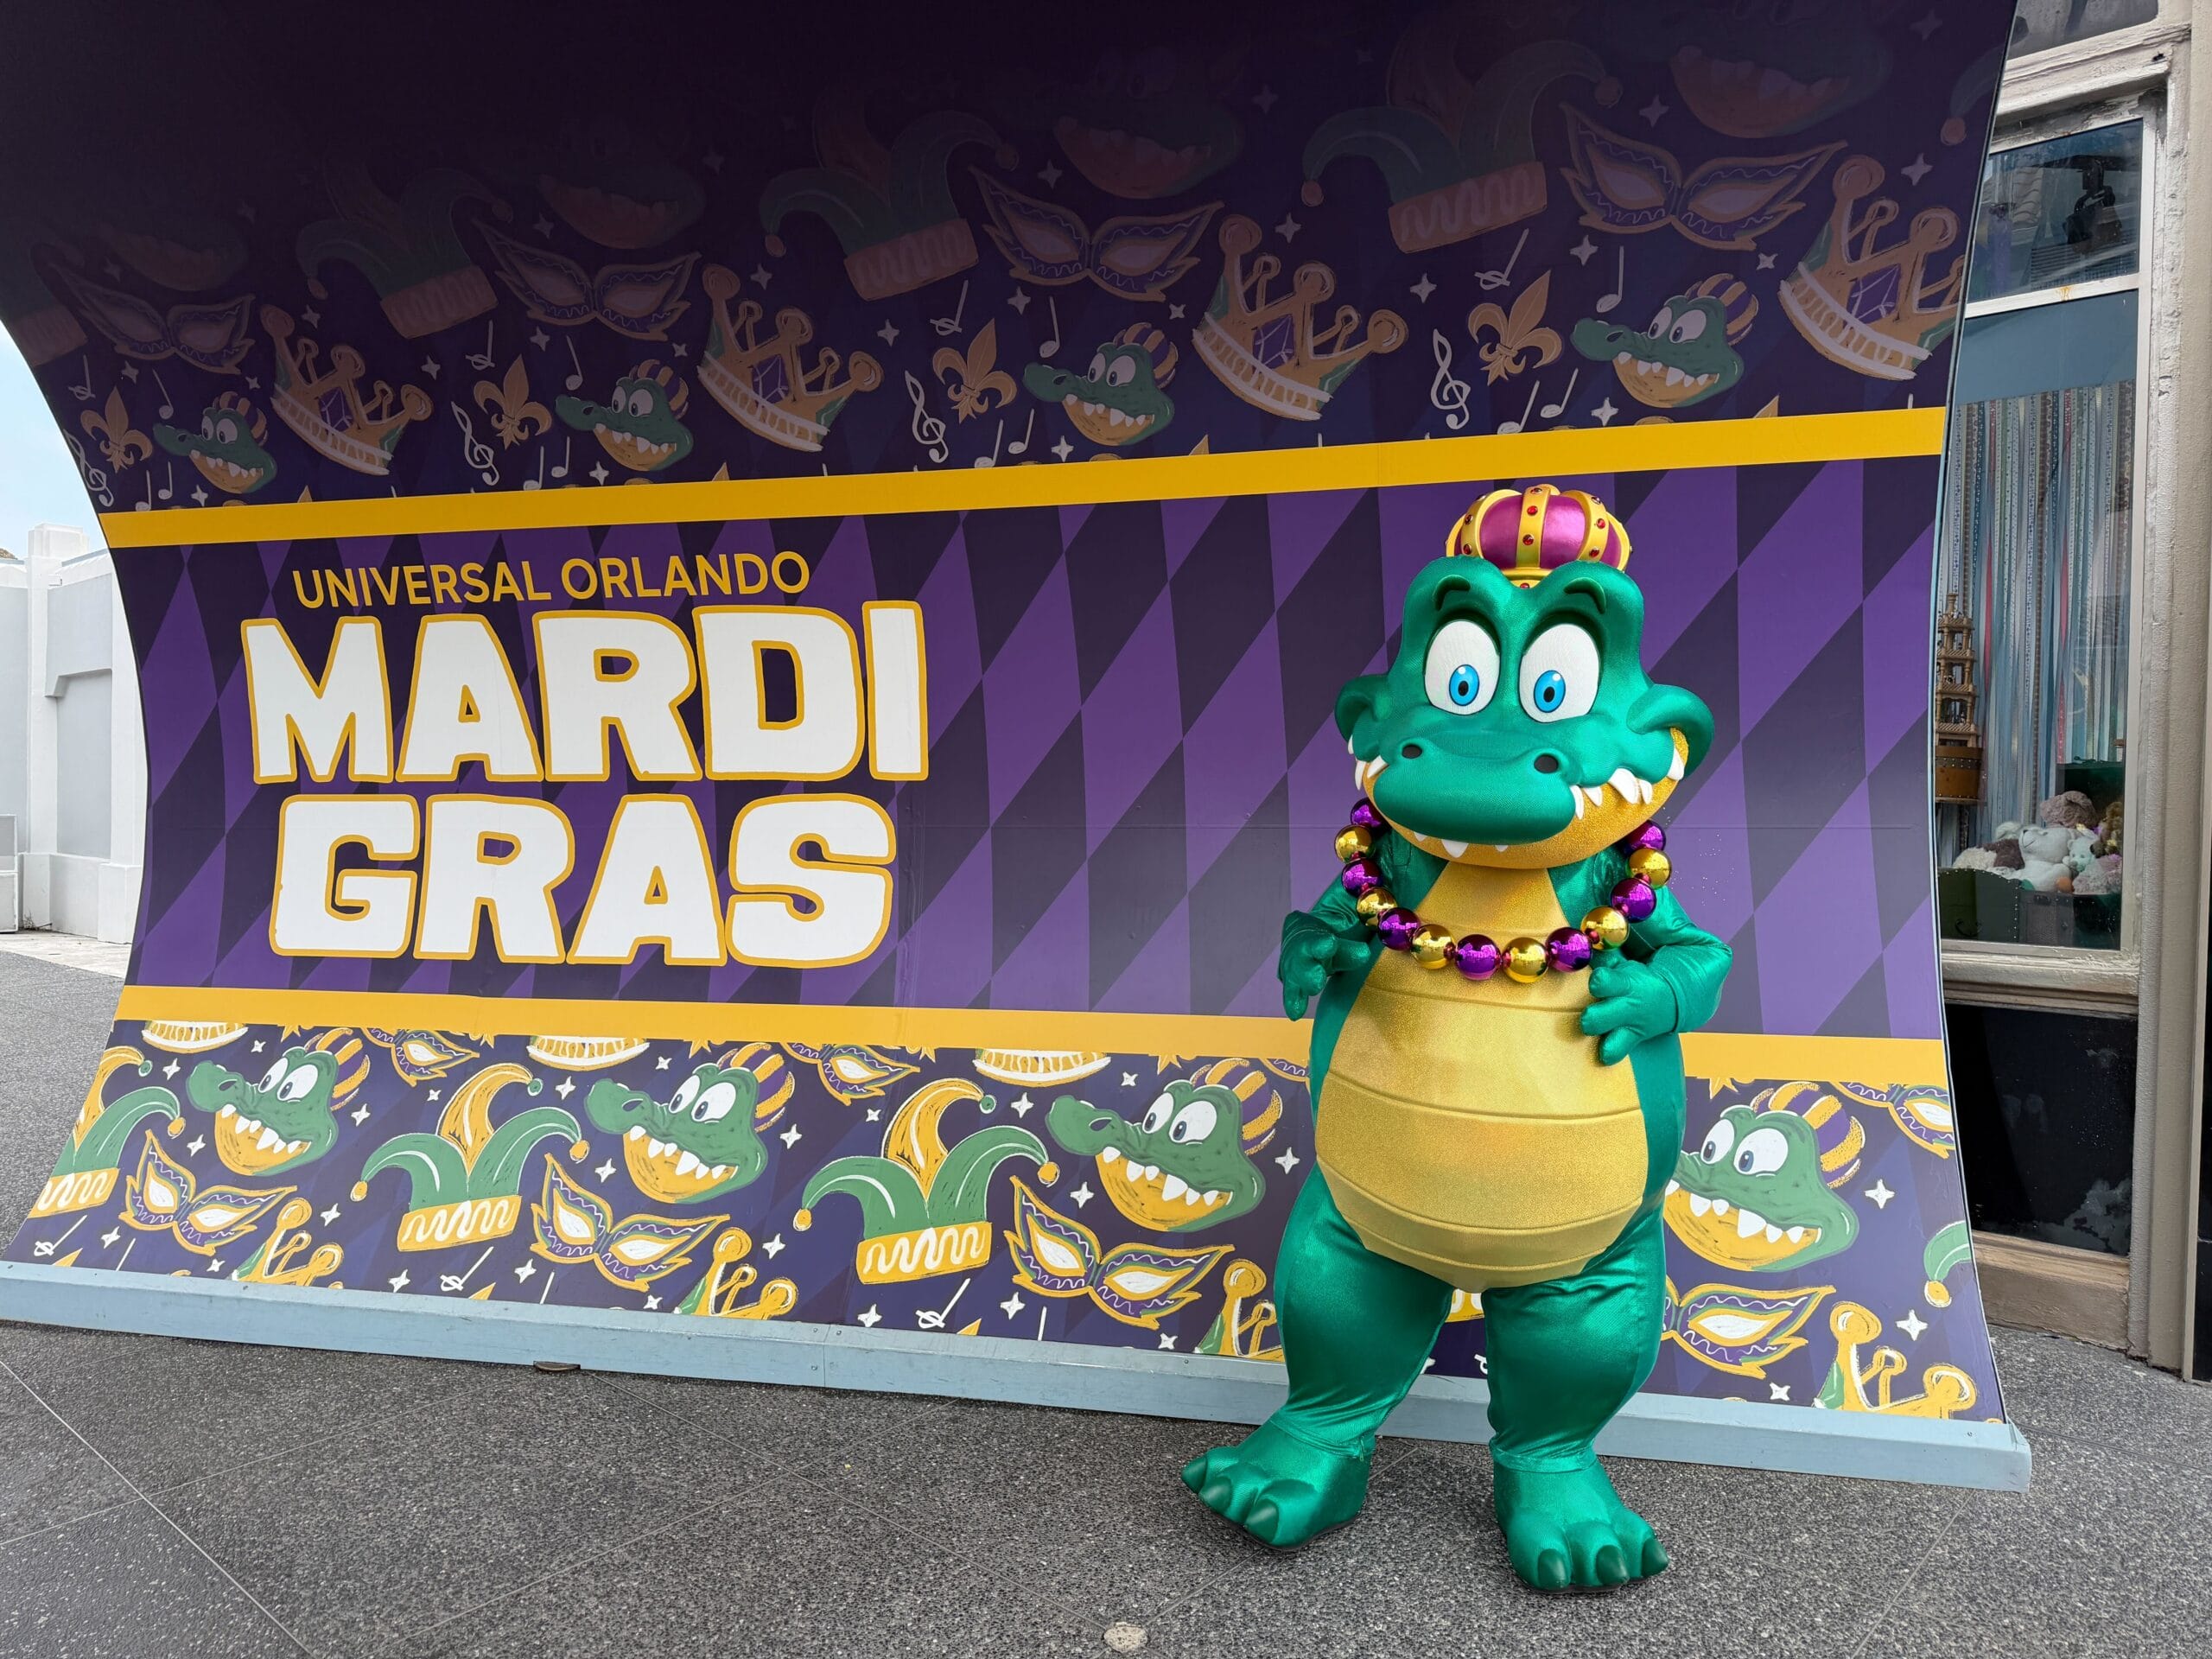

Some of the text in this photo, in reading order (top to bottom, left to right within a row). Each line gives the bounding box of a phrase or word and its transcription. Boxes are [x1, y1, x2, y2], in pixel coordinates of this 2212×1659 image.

[292, 550, 810, 608] UNIVERSAL ORLANDO
[240, 601, 928, 784] MARDI
[270, 792, 897, 968] GRAS
